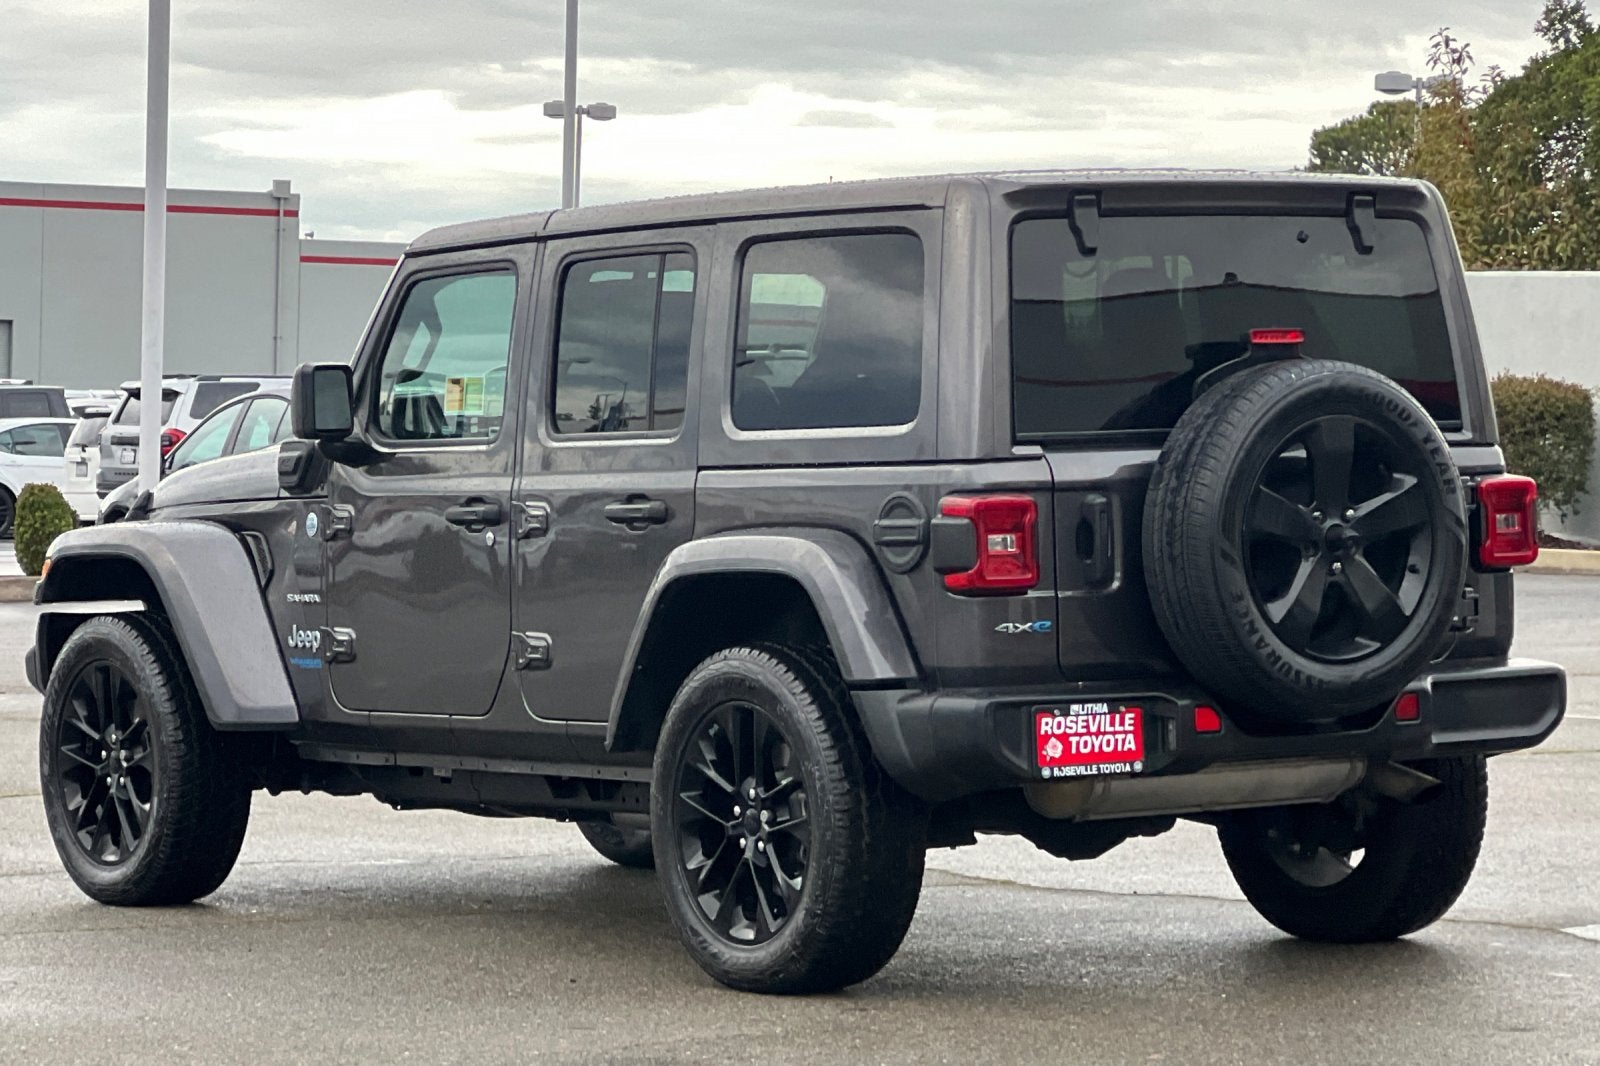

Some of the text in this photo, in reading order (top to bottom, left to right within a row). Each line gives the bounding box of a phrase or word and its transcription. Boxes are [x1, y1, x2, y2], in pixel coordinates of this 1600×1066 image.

[287, 594, 320, 602] SAHARA
[288, 624, 321, 652] Jeep
[1079, 703, 1109, 715] LITHIA
[1040, 713, 1135, 735] ROSEVILLE
[1068, 733, 1136, 754] TOYOTA
[1053, 762, 1131, 777] ROSEVILLE TOYOTA
